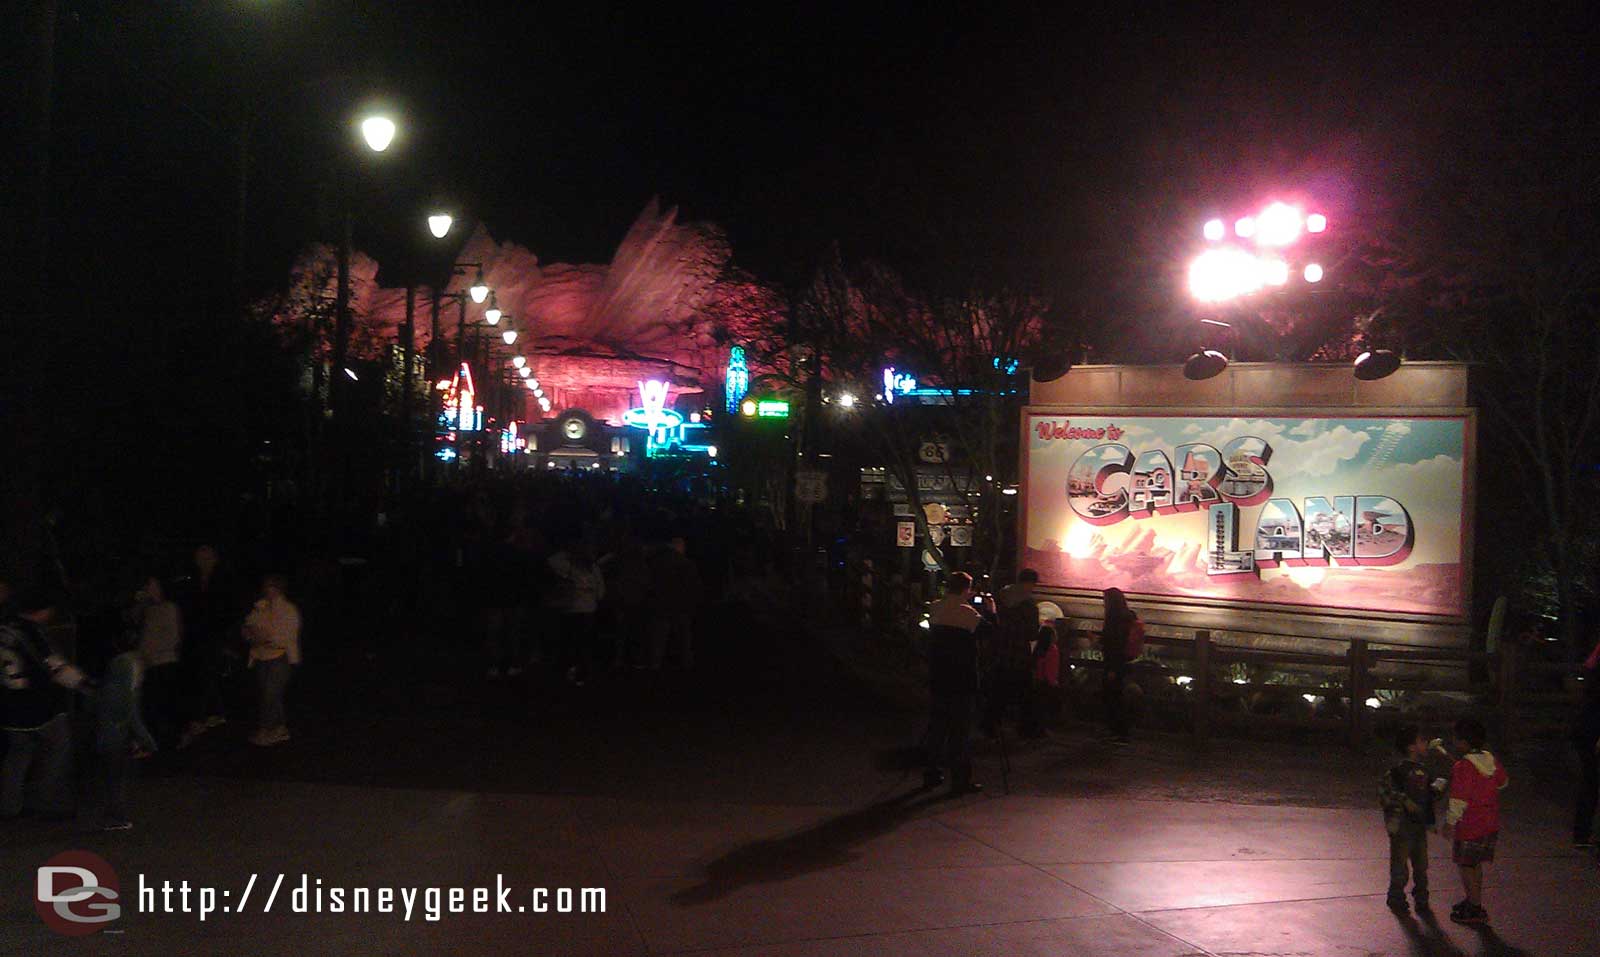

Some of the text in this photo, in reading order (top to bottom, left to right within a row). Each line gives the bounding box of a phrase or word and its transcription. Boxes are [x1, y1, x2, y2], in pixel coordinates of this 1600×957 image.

[1036, 421, 1125, 440] Welcome to
[1066, 435, 1274, 526] CARS
[1206, 494, 1415, 580] LAND
